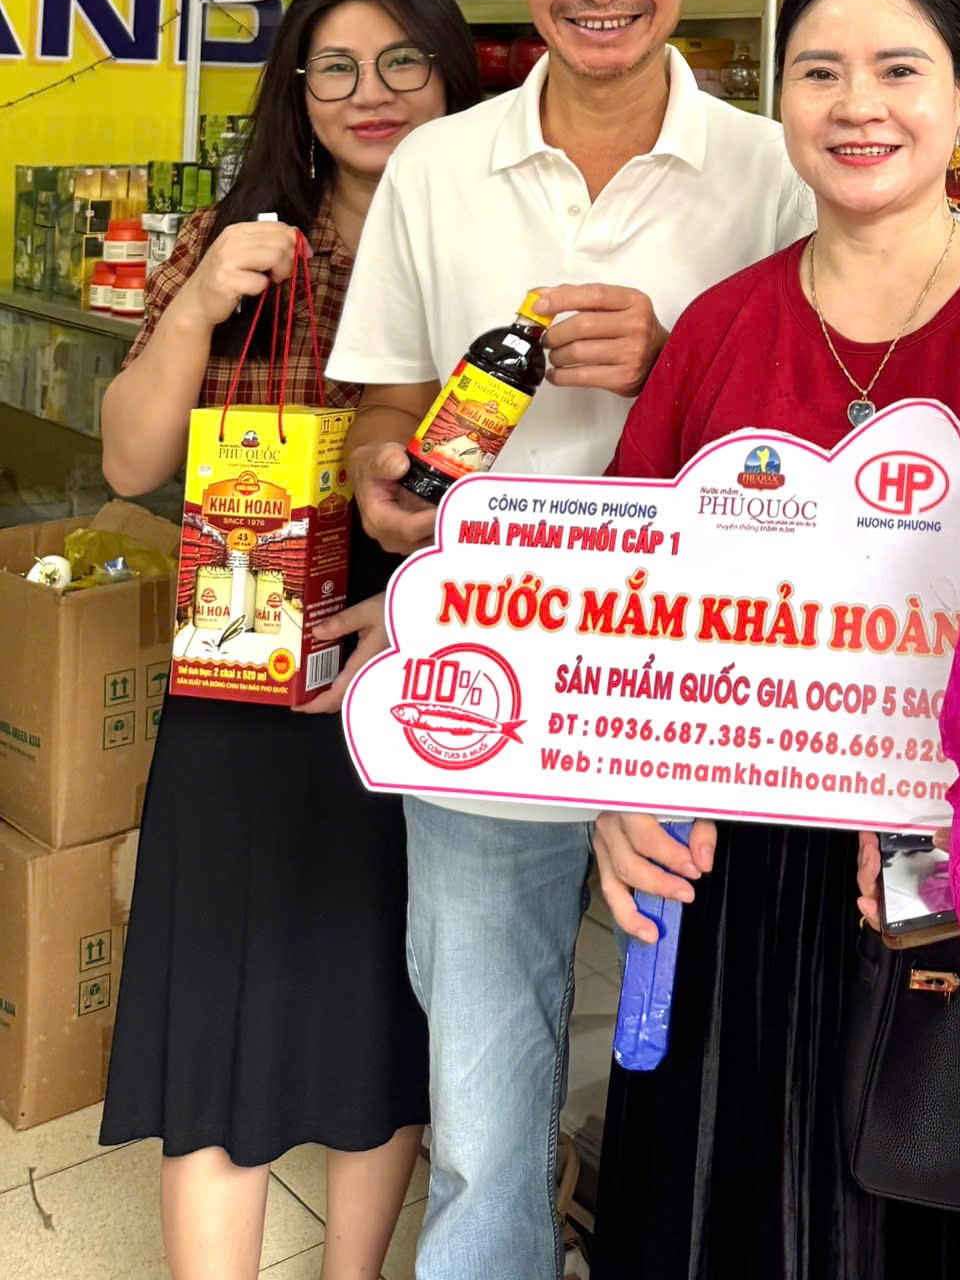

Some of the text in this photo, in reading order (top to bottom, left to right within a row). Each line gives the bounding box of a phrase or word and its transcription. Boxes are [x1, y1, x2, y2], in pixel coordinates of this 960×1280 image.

[878, 461, 935, 515] HP
[210, 493, 284, 516] KHẢI HOÀN
[488, 493, 658, 519] CÔNG TY HƯƠNG PHƯƠNG
[238, 533, 248, 542] 43
[458, 517, 681, 556] NHÀ PHÂN PHỐI CẤP 1
[437, 571, 570, 632] NƯỚC
[577, 567, 690, 640] MẮM
[696, 580, 821, 648] KHẢI
[213, 668, 218, 677] 2
[220, 668, 236, 678] chai
[402, 657, 483, 706] 100%
[554, 654, 603, 696] SẢN
[606, 653, 675, 701] PHẨM
[679, 661, 752, 706] QUỐC
[757, 677, 799, 709] GIA
[805, 680, 877, 715] OCOP
[882, 686, 897, 716] 5
[548, 712, 579, 736] ĐT
[540, 747, 590, 773] Web
